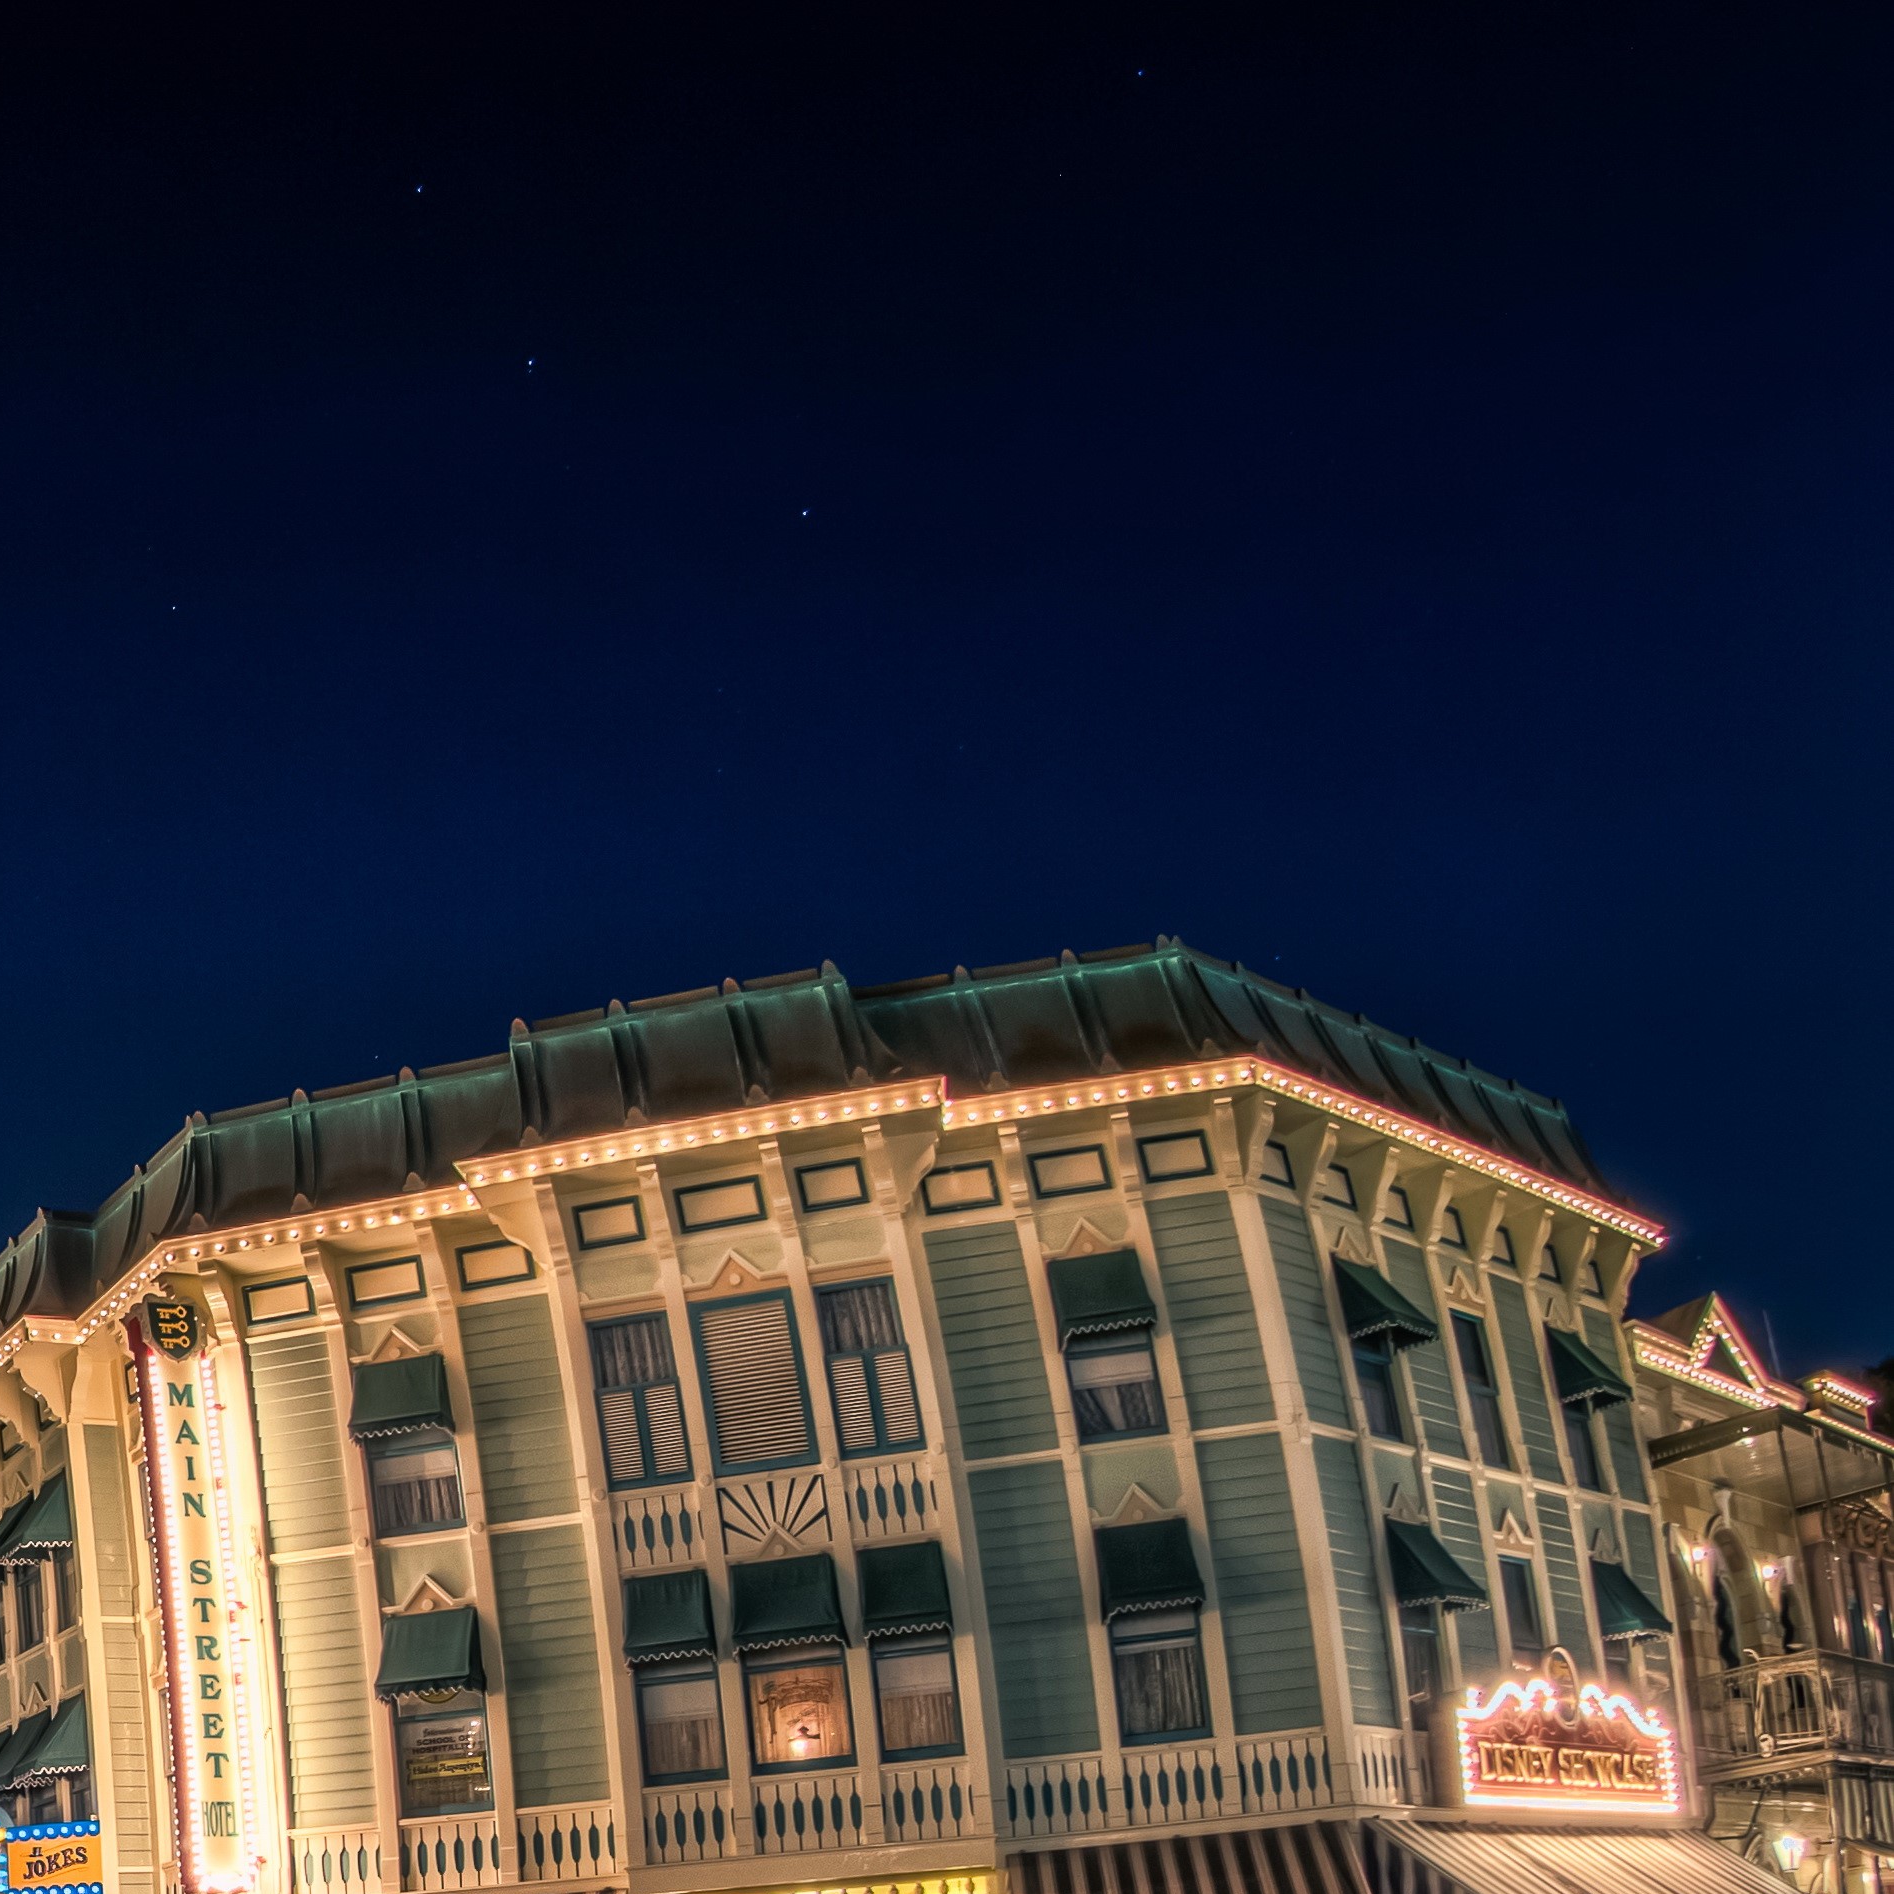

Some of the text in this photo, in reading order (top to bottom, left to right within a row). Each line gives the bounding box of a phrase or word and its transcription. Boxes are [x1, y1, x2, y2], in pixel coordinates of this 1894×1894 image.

[167, 1383, 229, 1780] MAIN STREET
[417, 1736, 455, 1747] SCHOOL
[1478, 1742, 1657, 1790] DISNEY SHOWCASE
[201, 1801, 239, 1838] HOTEL
[23, 1846, 88, 1880] JOKES
